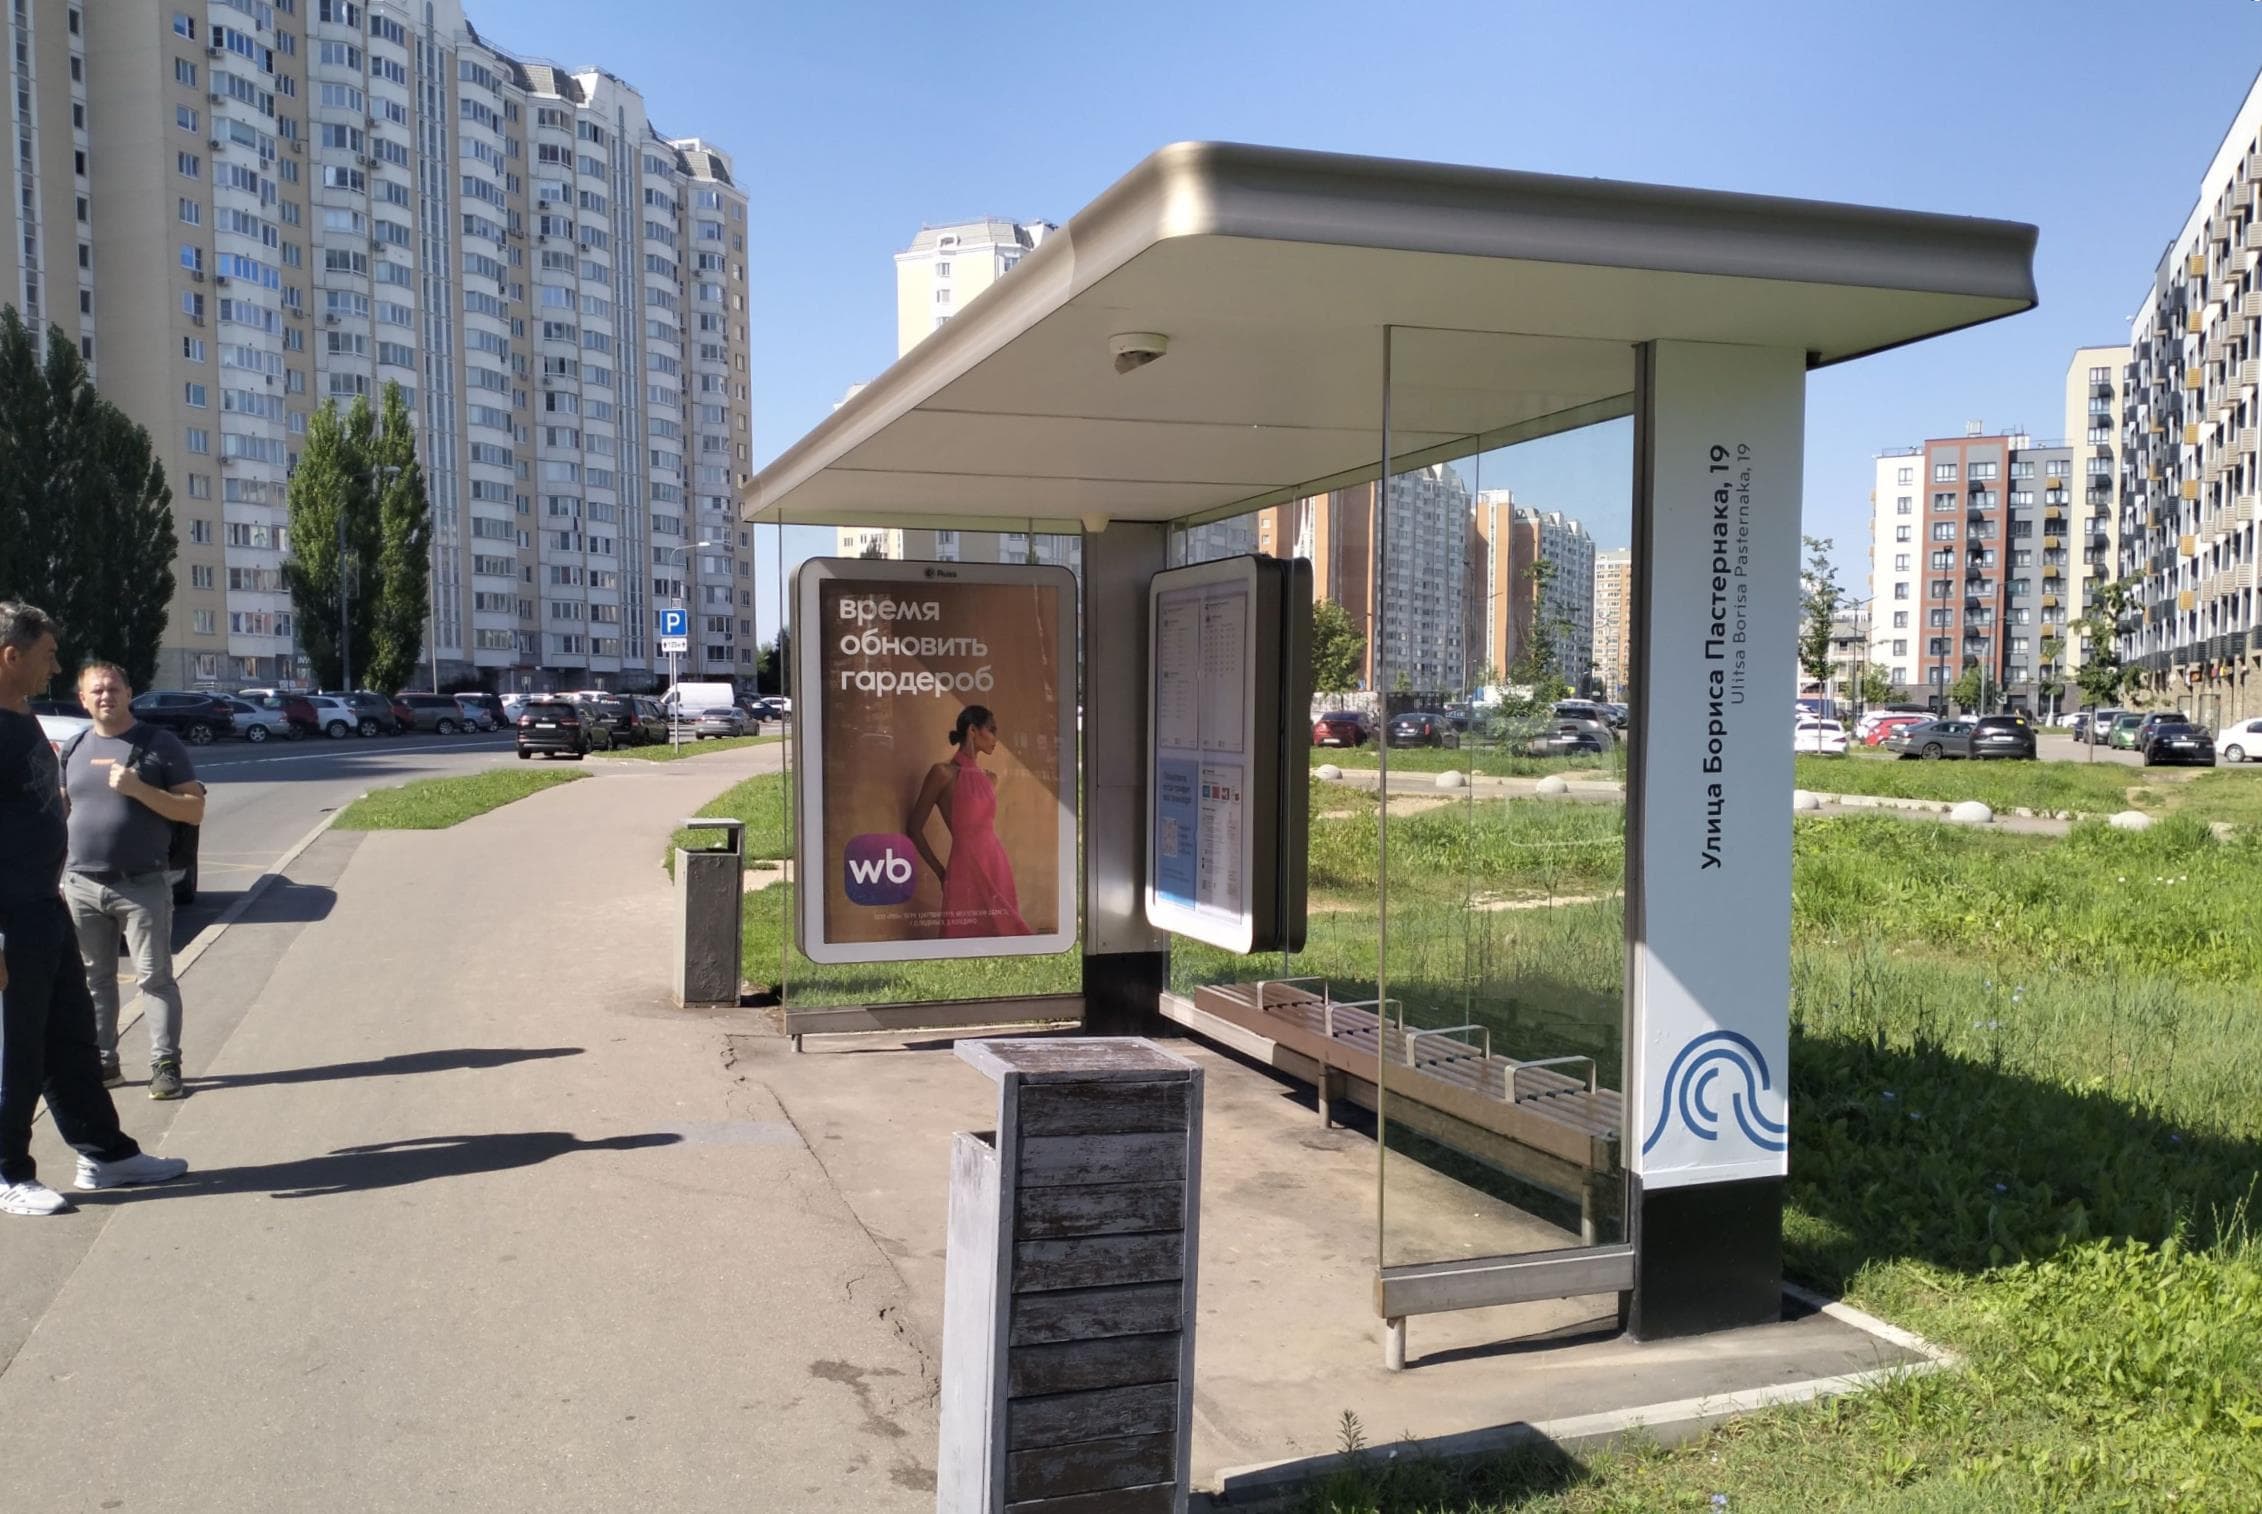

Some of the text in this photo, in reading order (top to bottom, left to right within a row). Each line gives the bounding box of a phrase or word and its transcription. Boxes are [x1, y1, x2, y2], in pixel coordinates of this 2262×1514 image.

[1731, 443, 1752, 705] Ulitsa Borisa Pasternaka, 19
[667, 612, 680, 633] P
[839, 599, 940, 626] время
[840, 627, 988, 657] обновить
[1701, 444, 1733, 870] Улица Бориса Пастернака, 19
[841, 664, 995, 698] гардероб
[848, 848, 913, 885] wb
